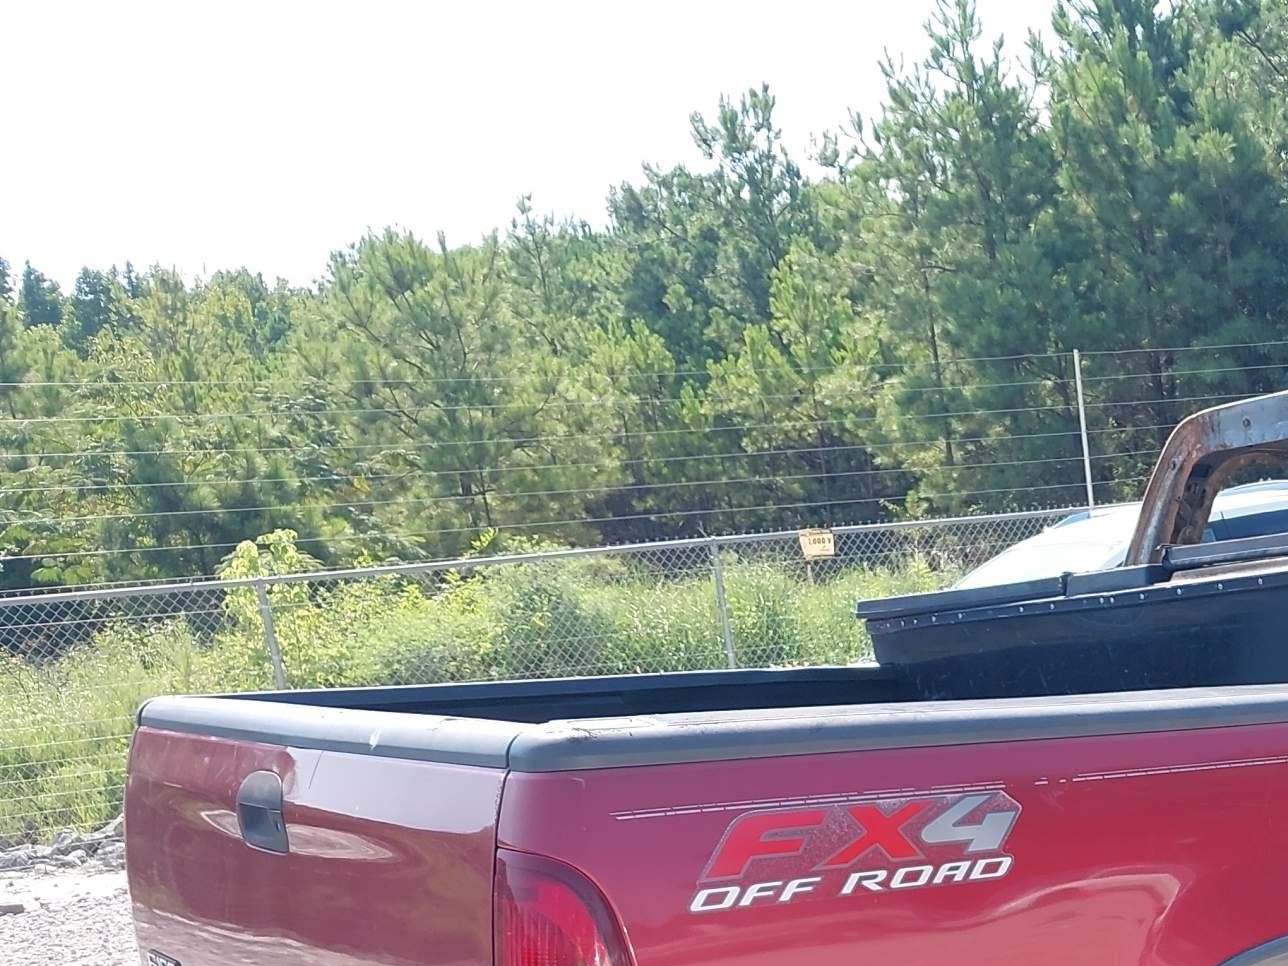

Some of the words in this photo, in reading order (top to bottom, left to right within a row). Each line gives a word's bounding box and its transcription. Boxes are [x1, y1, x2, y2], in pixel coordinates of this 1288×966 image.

[702, 795, 1016, 879] FX4
[690, 876, 822, 912] OFF
[841, 856, 1013, 895] ROAD
